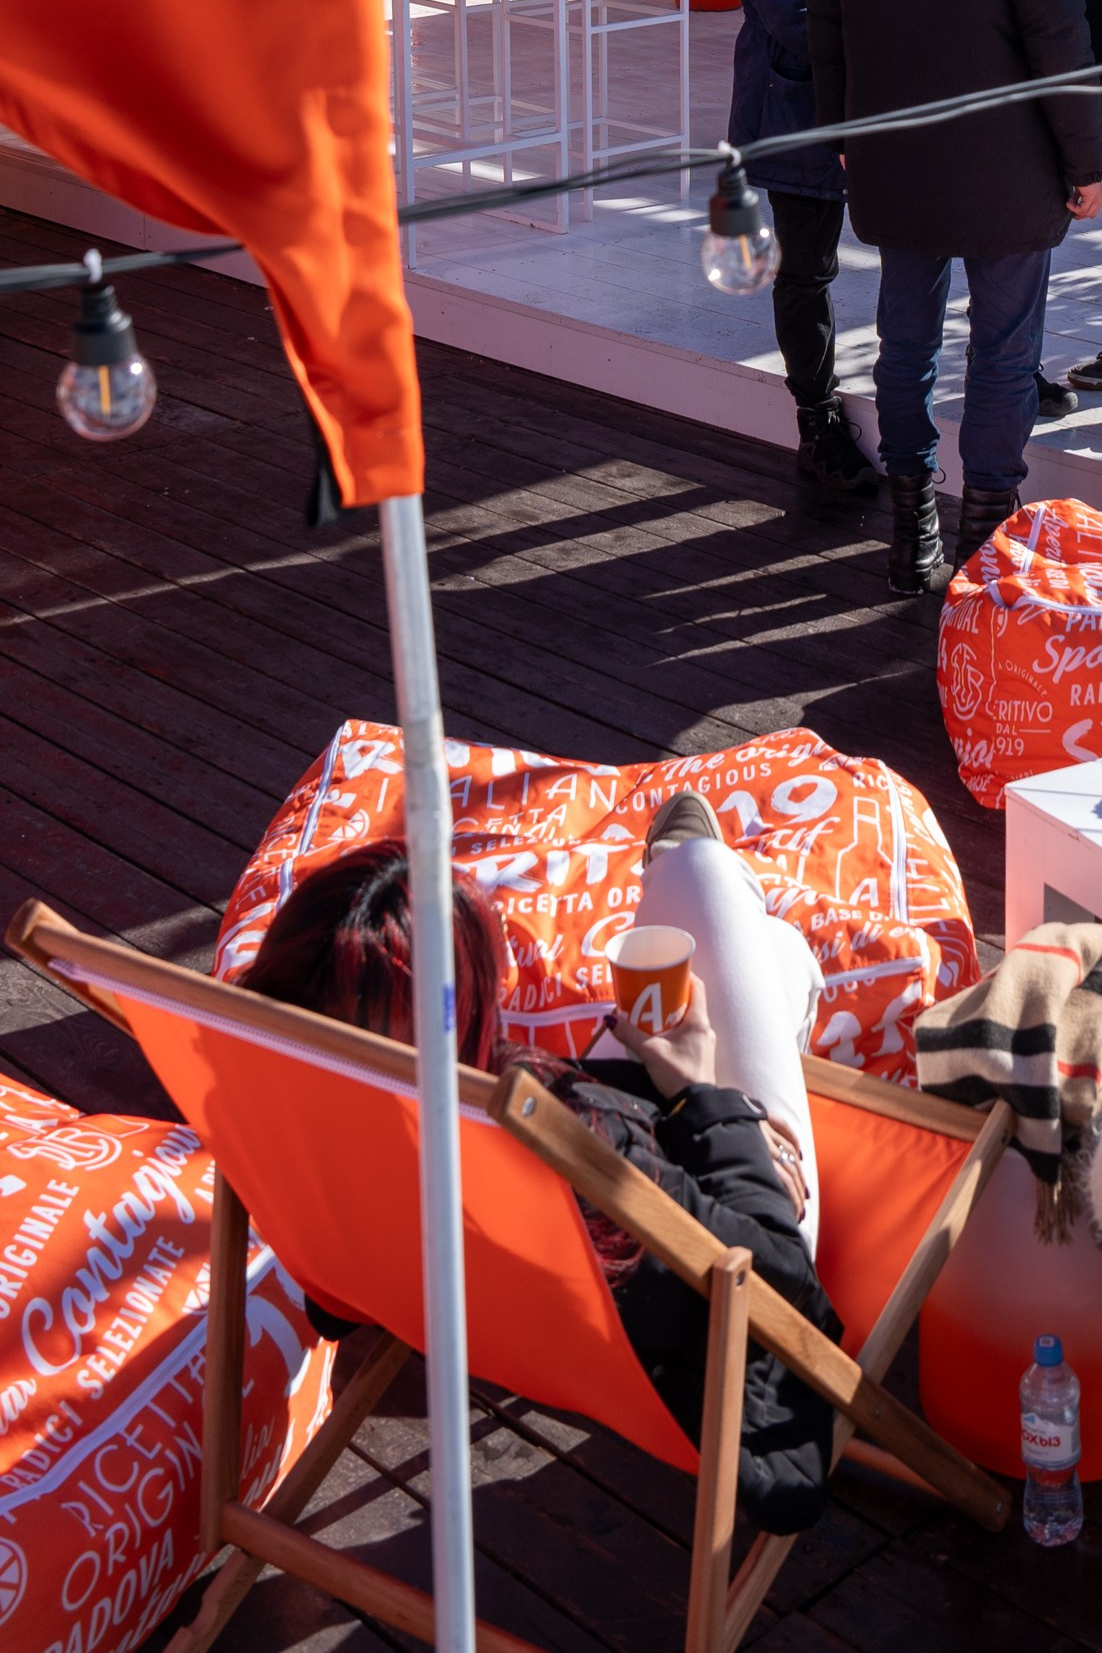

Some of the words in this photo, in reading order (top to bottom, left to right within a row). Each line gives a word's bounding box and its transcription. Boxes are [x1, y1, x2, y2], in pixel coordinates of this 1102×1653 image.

[993, 699, 1053, 724] RITIVO
[996, 723, 1018, 736] DAL
[376, 772, 617, 813] IALIAN
[849, 877, 879, 908] A
[811, 907, 863, 932] BASE
[22, 1123, 202, 1376] Contagiou
[77, 1236, 185, 1400] SELEZIONATE
[1022, 1429, 1061, 1448] ХЫЗ
